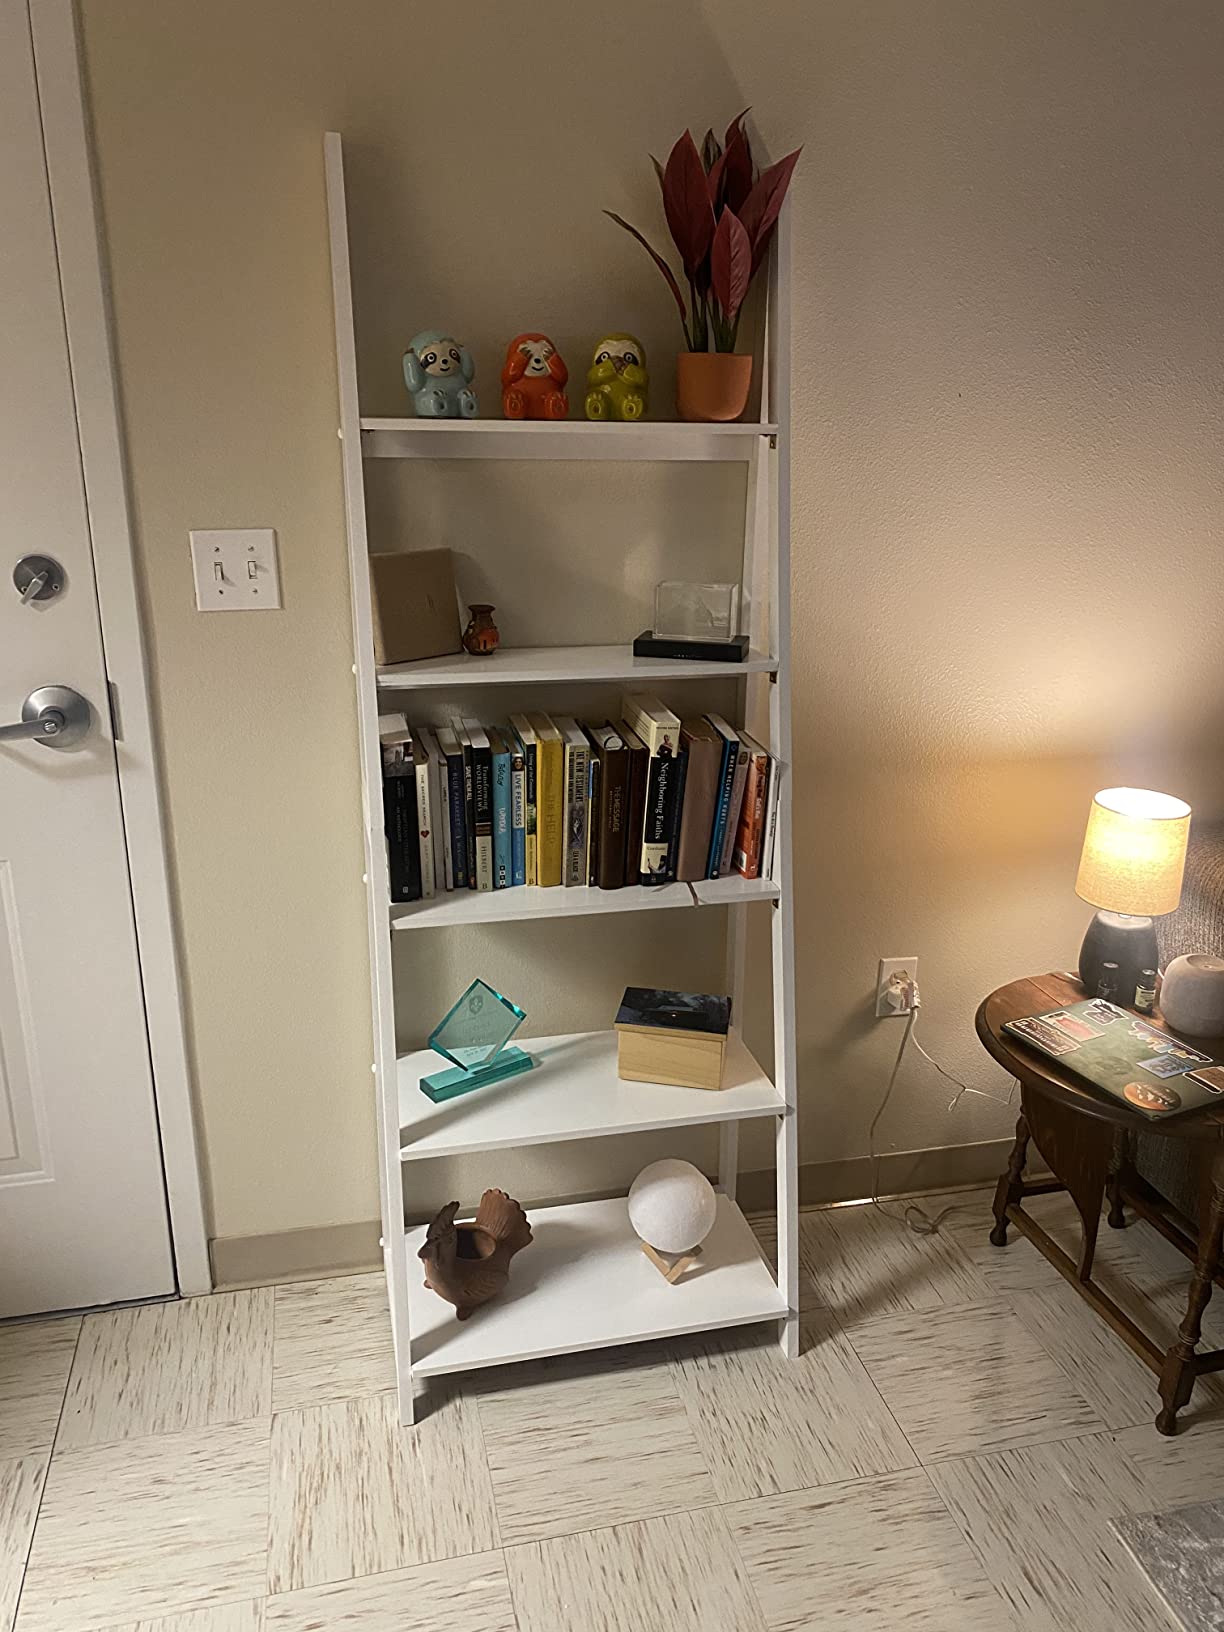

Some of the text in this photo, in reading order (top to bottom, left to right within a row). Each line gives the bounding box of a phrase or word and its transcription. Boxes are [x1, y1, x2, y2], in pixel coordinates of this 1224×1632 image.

[575, 761, 585, 772] NEW
[727, 753, 736, 773] WHEN
[475, 763, 483, 812] WORLDVIEWS
[482, 765, 490, 810] Transforming
[514, 774, 522, 789] LIVE
[722, 774, 733, 802] HELPING
[514, 791, 522, 826] FEARLESS
[654, 762, 668, 840] Neighboring Faiths
[719, 804, 729, 825] HURTS
